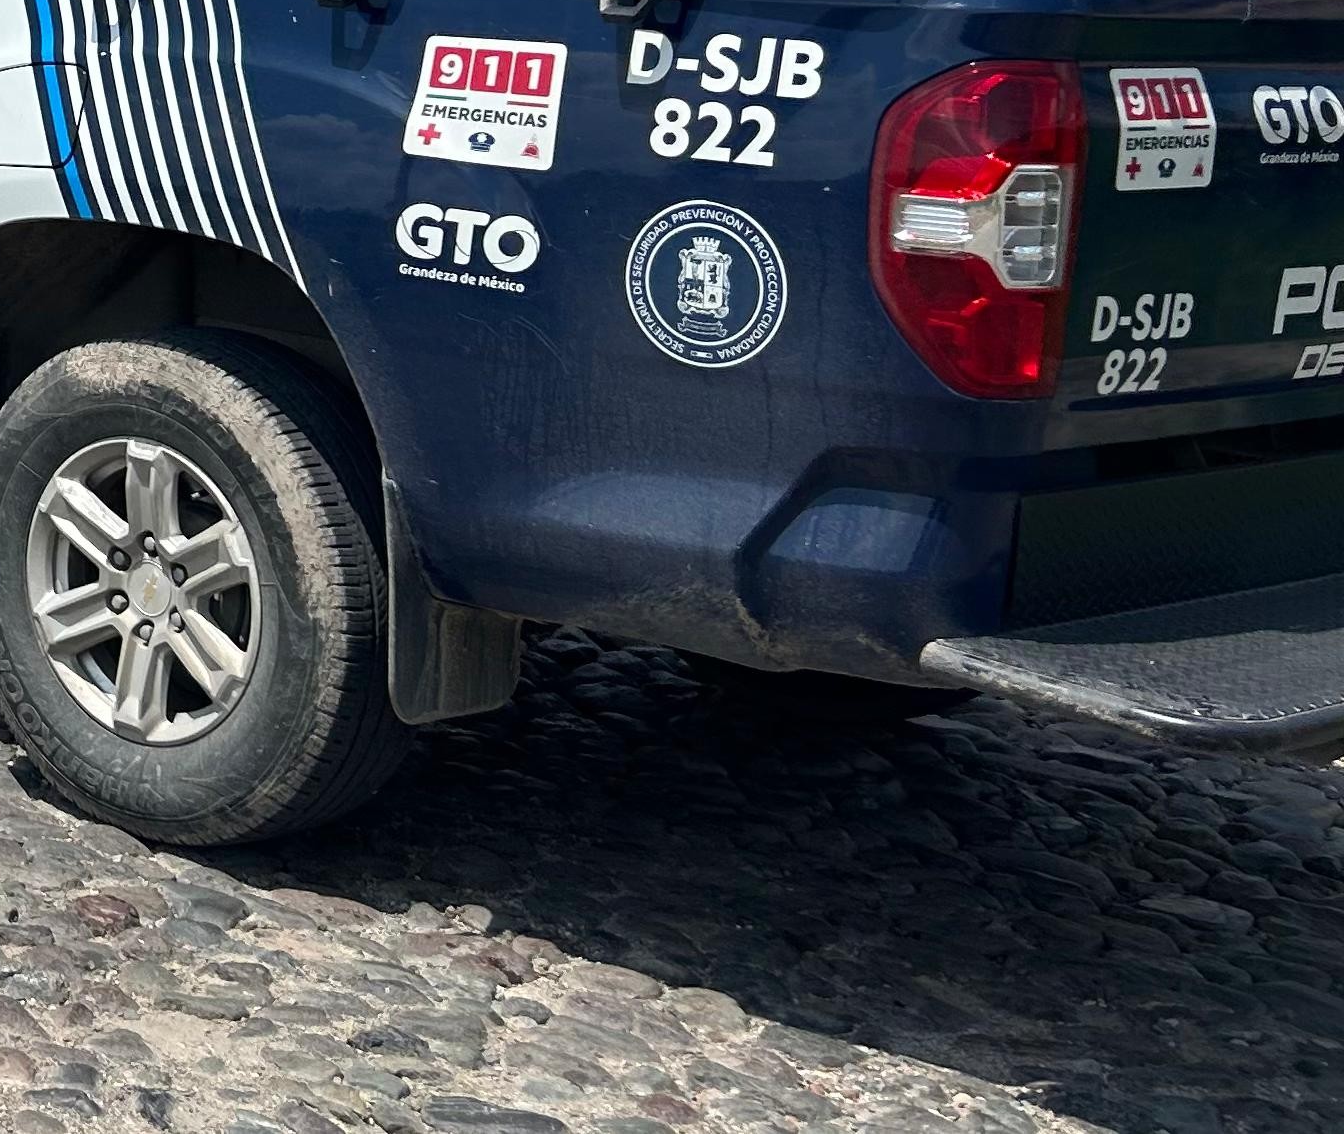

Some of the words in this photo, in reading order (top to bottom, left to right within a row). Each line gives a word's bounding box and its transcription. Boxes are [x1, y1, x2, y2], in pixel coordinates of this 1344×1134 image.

[436, 52, 544, 91] 911
[625, 28, 825, 100] D-SJB
[421, 103, 548, 129] EMERGENCIAS
[1126, 83, 1199, 116] 911
[1253, 85, 1344, 144] GTO
[649, 97, 777, 168] 822
[1125, 134, 1210, 151] EMERGENCIAS
[1300, 150, 1310, 163] de
[395, 202, 541, 273] GTO
[671, 207, 745, 232] PREVENCIÓN
[743, 225, 754, 238] Y
[399, 263, 458, 283] Grandeza
[459, 272, 477, 286] de
[478, 276, 526, 293] México
[631, 279, 643, 296] DE
[749, 234, 781, 313] PROTECCIÓN
[716, 313, 773, 360] CIUDADANA
[1090, 292, 1195, 343] D-SJB
[1097, 347, 1168, 395] 822
